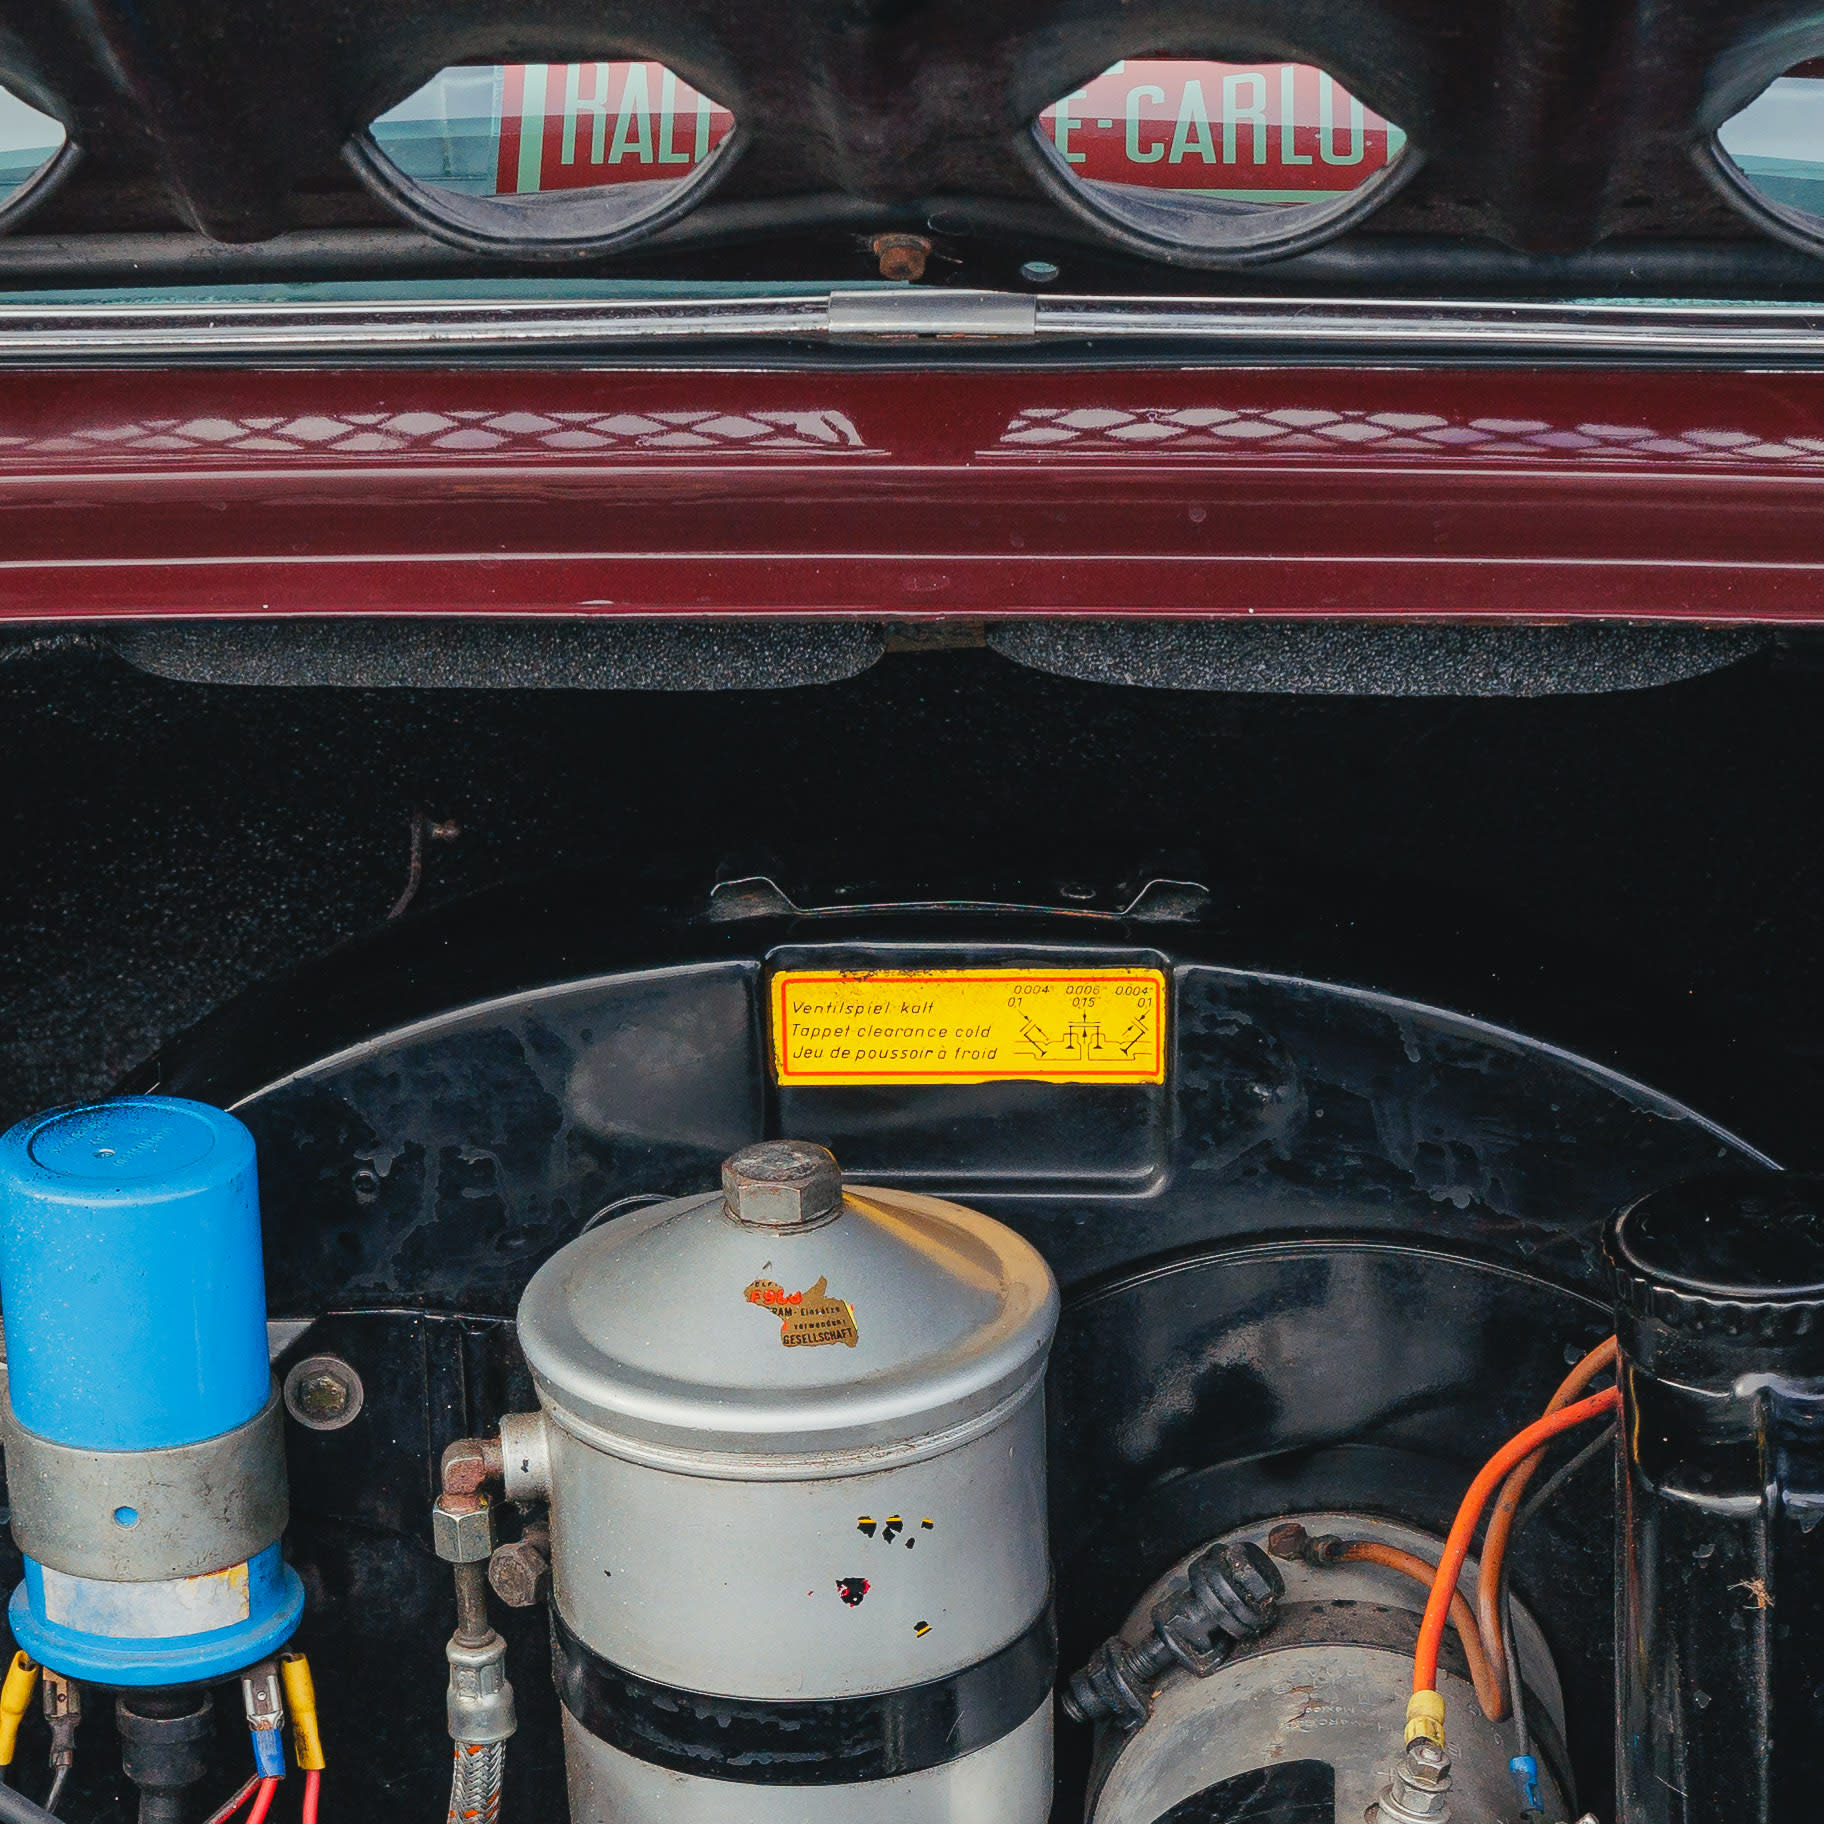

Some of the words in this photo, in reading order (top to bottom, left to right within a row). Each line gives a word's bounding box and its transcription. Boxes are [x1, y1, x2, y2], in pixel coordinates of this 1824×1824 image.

[792, 1001, 891, 1017] Ventilspiel
[901, 1001, 935, 1015] kalt
[792, 1023, 850, 1039] Tappet
[857, 1024, 948, 1038] clearance
[955, 1025, 991, 1038] cold
[792, 1046, 824, 1060] Jeu
[830, 1047, 851, 1060] de
[855, 1048, 933, 1062] poussoir
[937, 1045, 948, 1060] à
[955, 1047, 998, 1060] froid
[783, 1328, 853, 1344] GESELLSCHAFT
